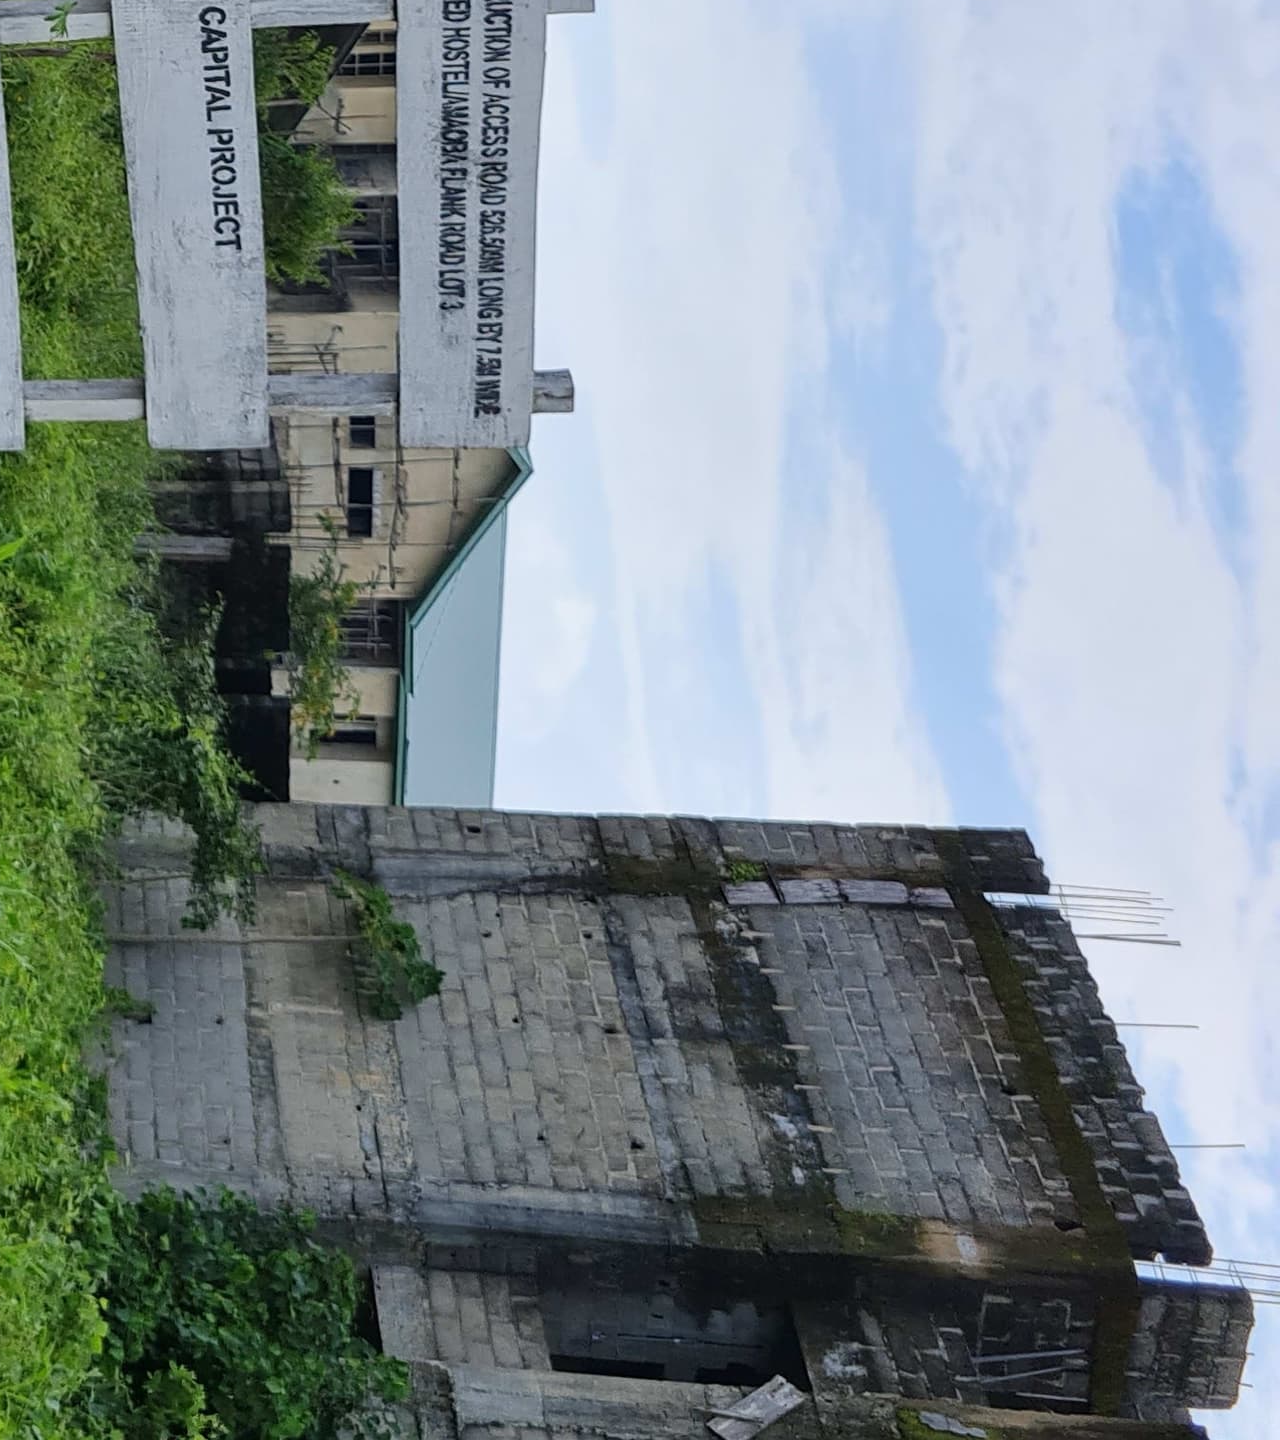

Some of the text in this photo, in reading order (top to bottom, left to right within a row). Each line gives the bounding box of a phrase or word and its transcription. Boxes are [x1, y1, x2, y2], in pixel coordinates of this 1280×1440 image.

[199, 6, 233, 122] CAPITAL
[483, 67, 511, 89] OF
[480, 93, 510, 158] ACCESS
[207, 128, 242, 251] PROJECT
[478, 161, 509, 206] ROAD
[439, 223, 467, 265] ROAD
[438, 269, 465, 298] LOT
[476, 277, 504, 319] LONG
[439, 301, 465, 311] 3
[475, 322, 503, 344] BY
